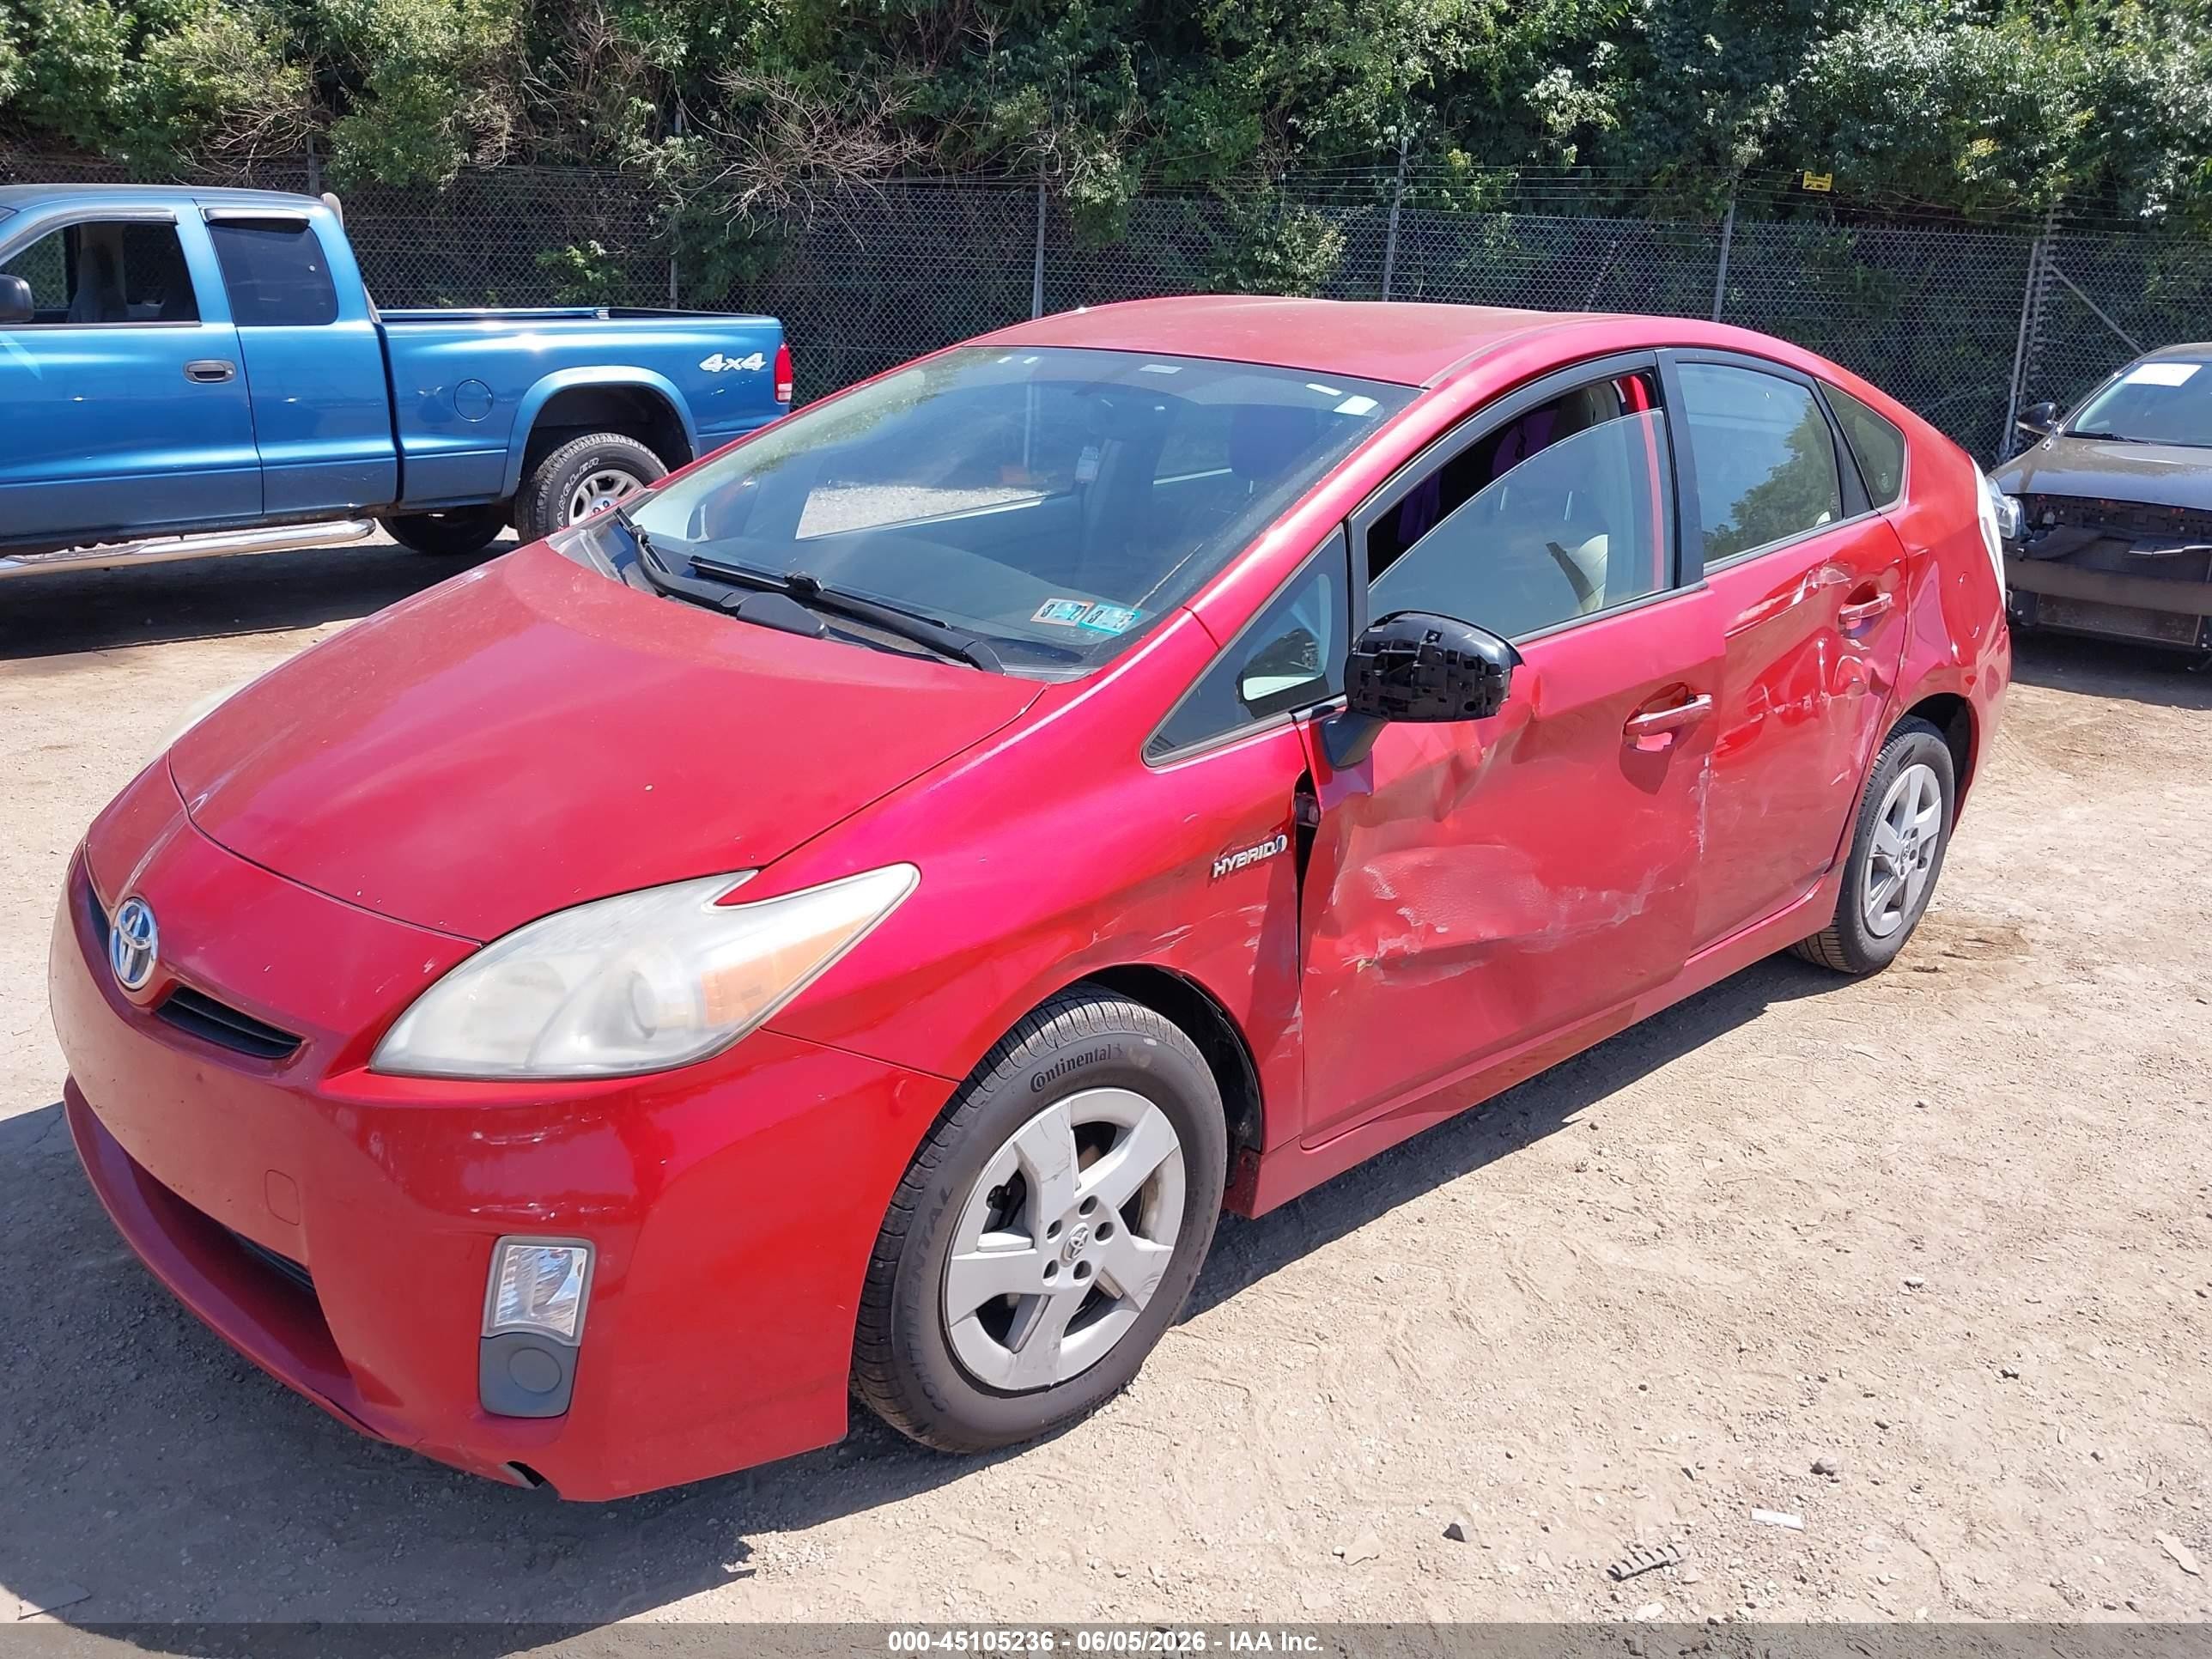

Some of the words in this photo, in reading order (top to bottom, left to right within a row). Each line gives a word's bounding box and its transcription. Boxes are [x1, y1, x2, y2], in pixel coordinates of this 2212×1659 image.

[699, 352, 767, 372] 4x4
[556, 457, 600, 531] ANGLER
[1212, 841, 1276, 878] HYBRID
[1030, 1044, 1111, 1093] Continental
